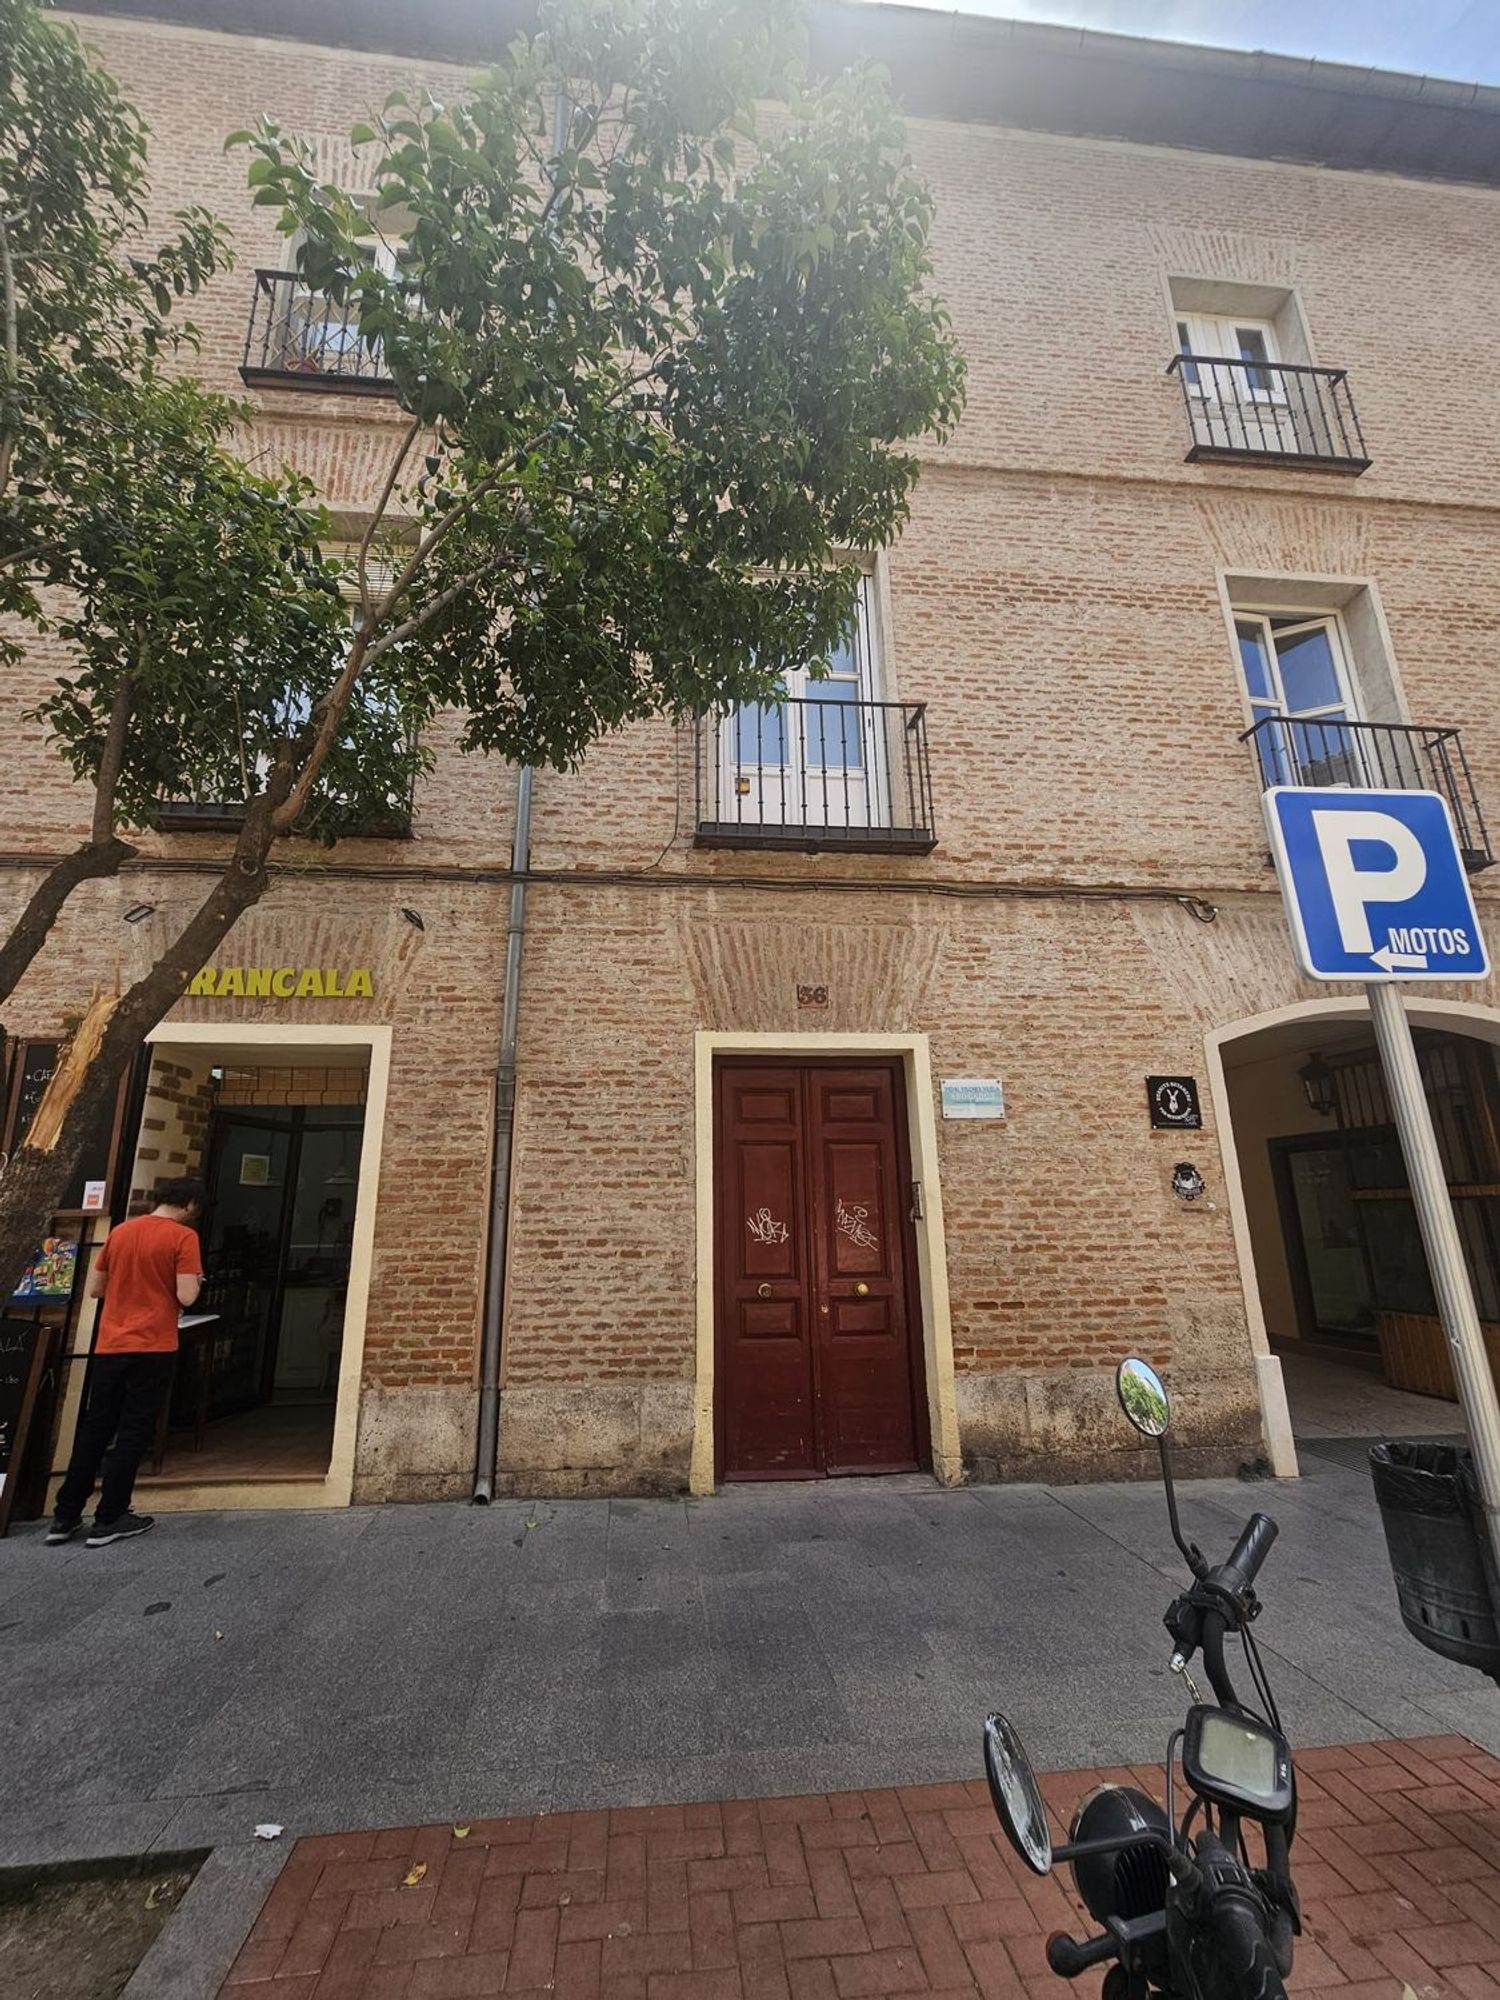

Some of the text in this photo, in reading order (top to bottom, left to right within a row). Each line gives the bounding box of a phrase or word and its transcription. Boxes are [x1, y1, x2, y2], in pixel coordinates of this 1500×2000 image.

[1312, 810, 1427, 953] P
[1388, 928, 1470, 954] MOTOS
[184, 966, 374, 997] RANCALA
